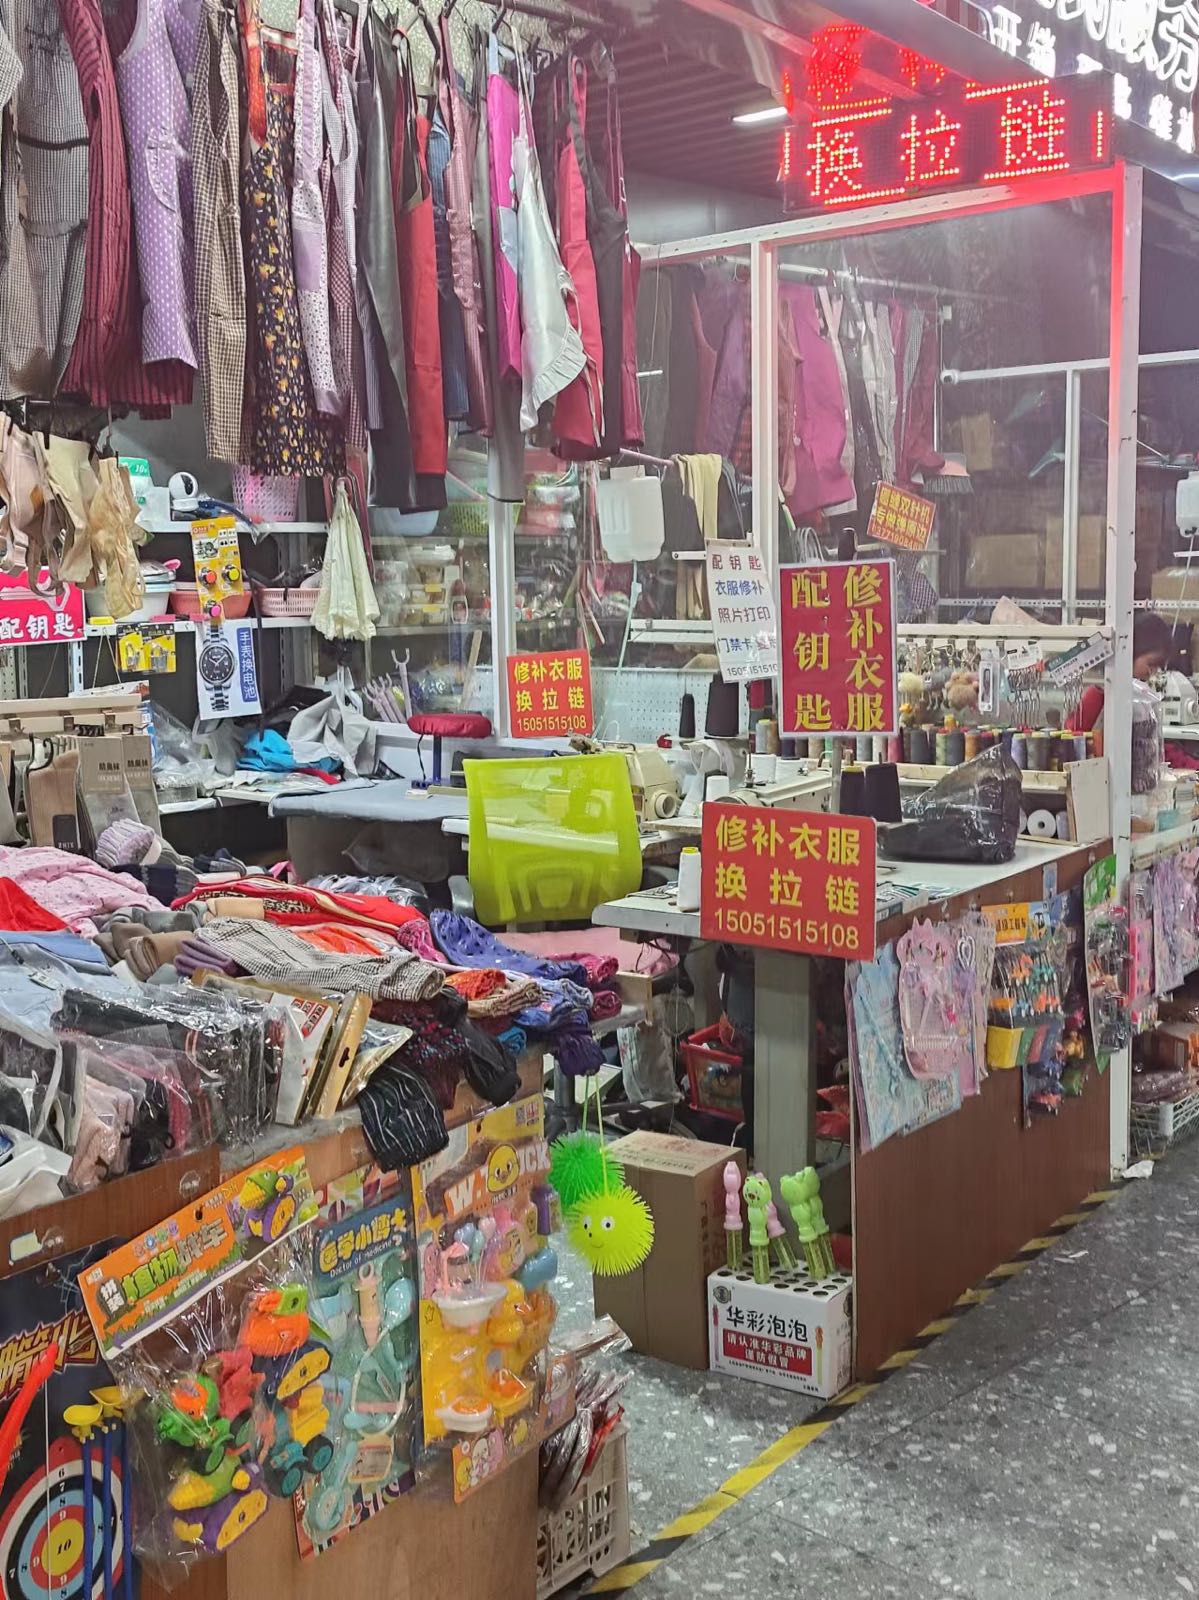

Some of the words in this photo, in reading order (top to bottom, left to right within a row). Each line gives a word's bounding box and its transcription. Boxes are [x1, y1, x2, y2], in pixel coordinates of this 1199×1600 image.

[711, 554, 762, 571] 配钥匙
[715, 579, 765, 597] 衣服修补
[718, 606, 771, 623] 照片打印
[0, 614, 78, 640] 配钥匙
[791, 569, 833, 732] 配钥匙
[842, 564, 887, 732] 修补衣服
[240, 630, 256, 700] 手表换电池
[514, 657, 583, 685] 修补衣服
[516, 686, 585, 712] 换拉链
[517, 714, 587, 732] 15051515108
[715, 814, 860, 866] 修补衣服
[715, 861, 860, 916] 换拉链
[714, 907, 860, 950] 15051515108
[726, 1305, 808, 1343] 华彩泡泡
[726, 1331, 808, 1361] 请认准华彩品牌
[58, 1468, 65, 1477] 6
[59, 1482, 66, 1492] 7
[60, 1497, 66, 1507] 8
[59, 1510, 67, 1521] 9
[57, 1539, 72, 1555] 10
[21, 1563, 28, 1573] 8
[33, 1556, 40, 1568] 9
[9, 1568, 16, 1578] 7
[60, 1574, 68, 1585] 9
